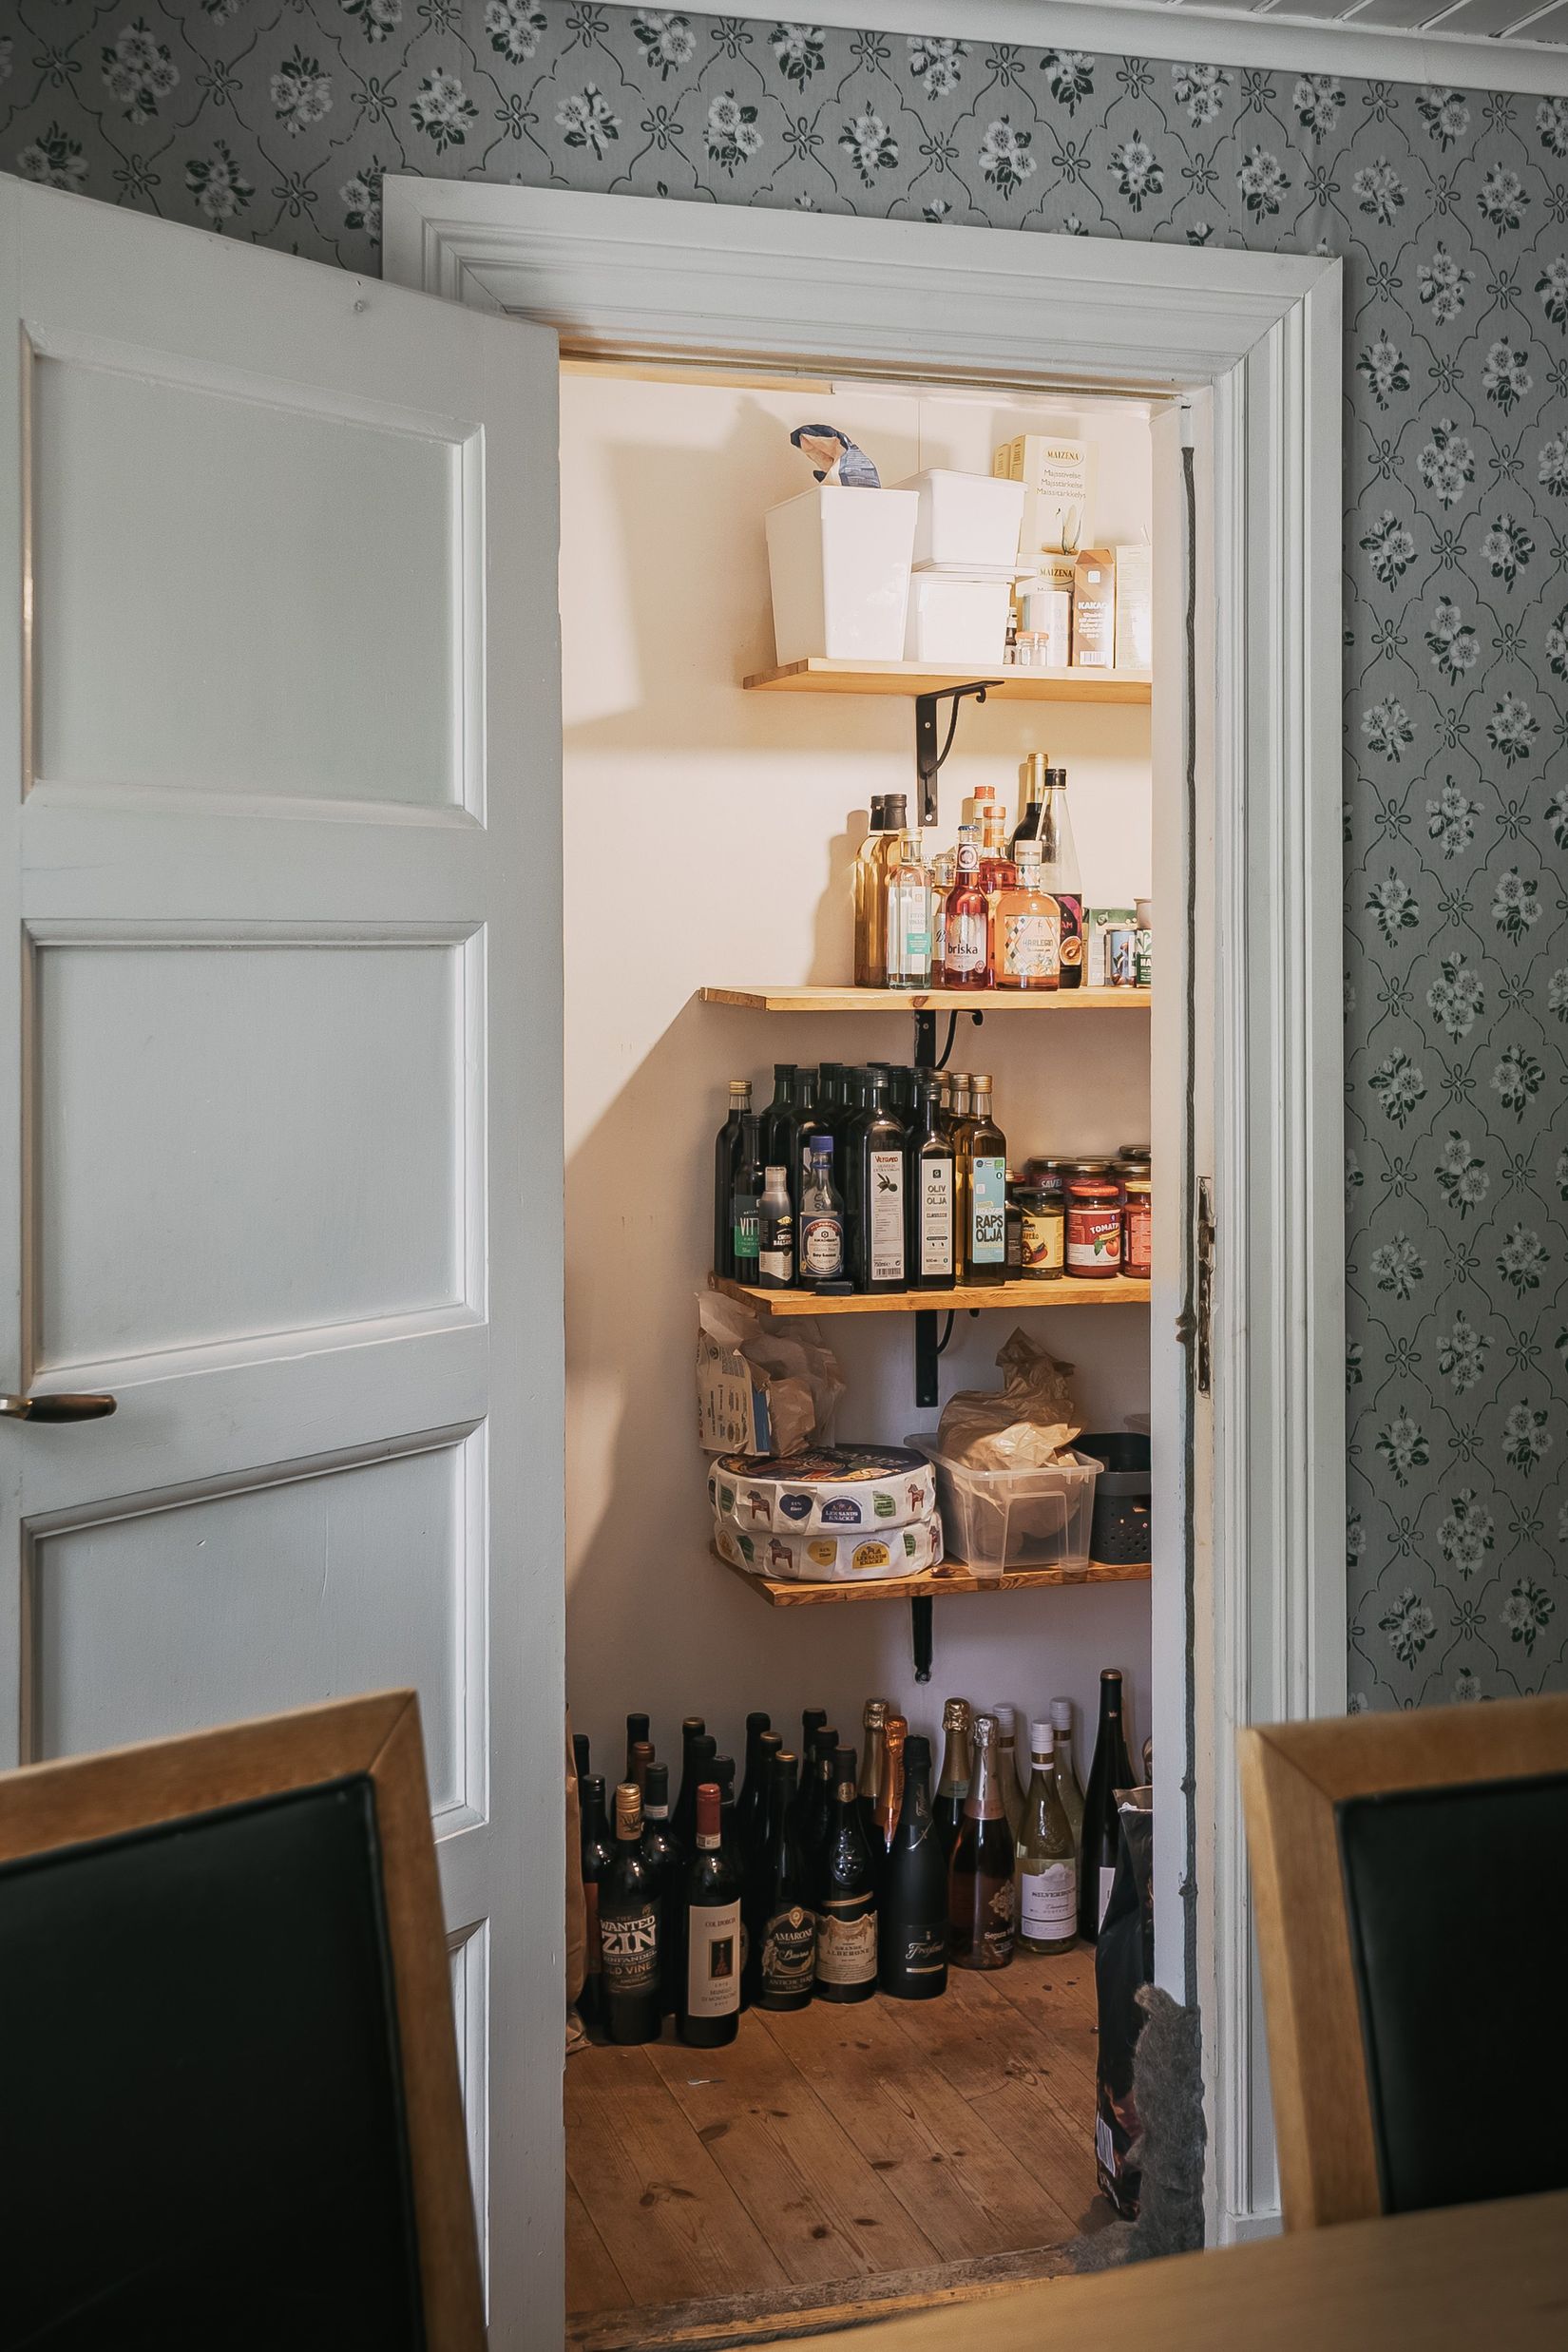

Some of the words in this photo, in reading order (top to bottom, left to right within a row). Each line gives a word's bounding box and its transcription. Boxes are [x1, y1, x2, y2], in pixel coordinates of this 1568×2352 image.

[1047, 449, 1080, 461] MAIZENA
[1039, 568, 1073, 579] MAIZENA
[947, 942, 978, 954] briska
[927, 1185, 947, 1194] OLIV
[927, 1196, 947, 1205] OLJA
[976, 1214, 1004, 1229] RAPS
[976, 1229, 1003, 1242] OLJA
[600, 1915, 655, 1933] WANTED
[601, 1924, 657, 1955] ZIN
